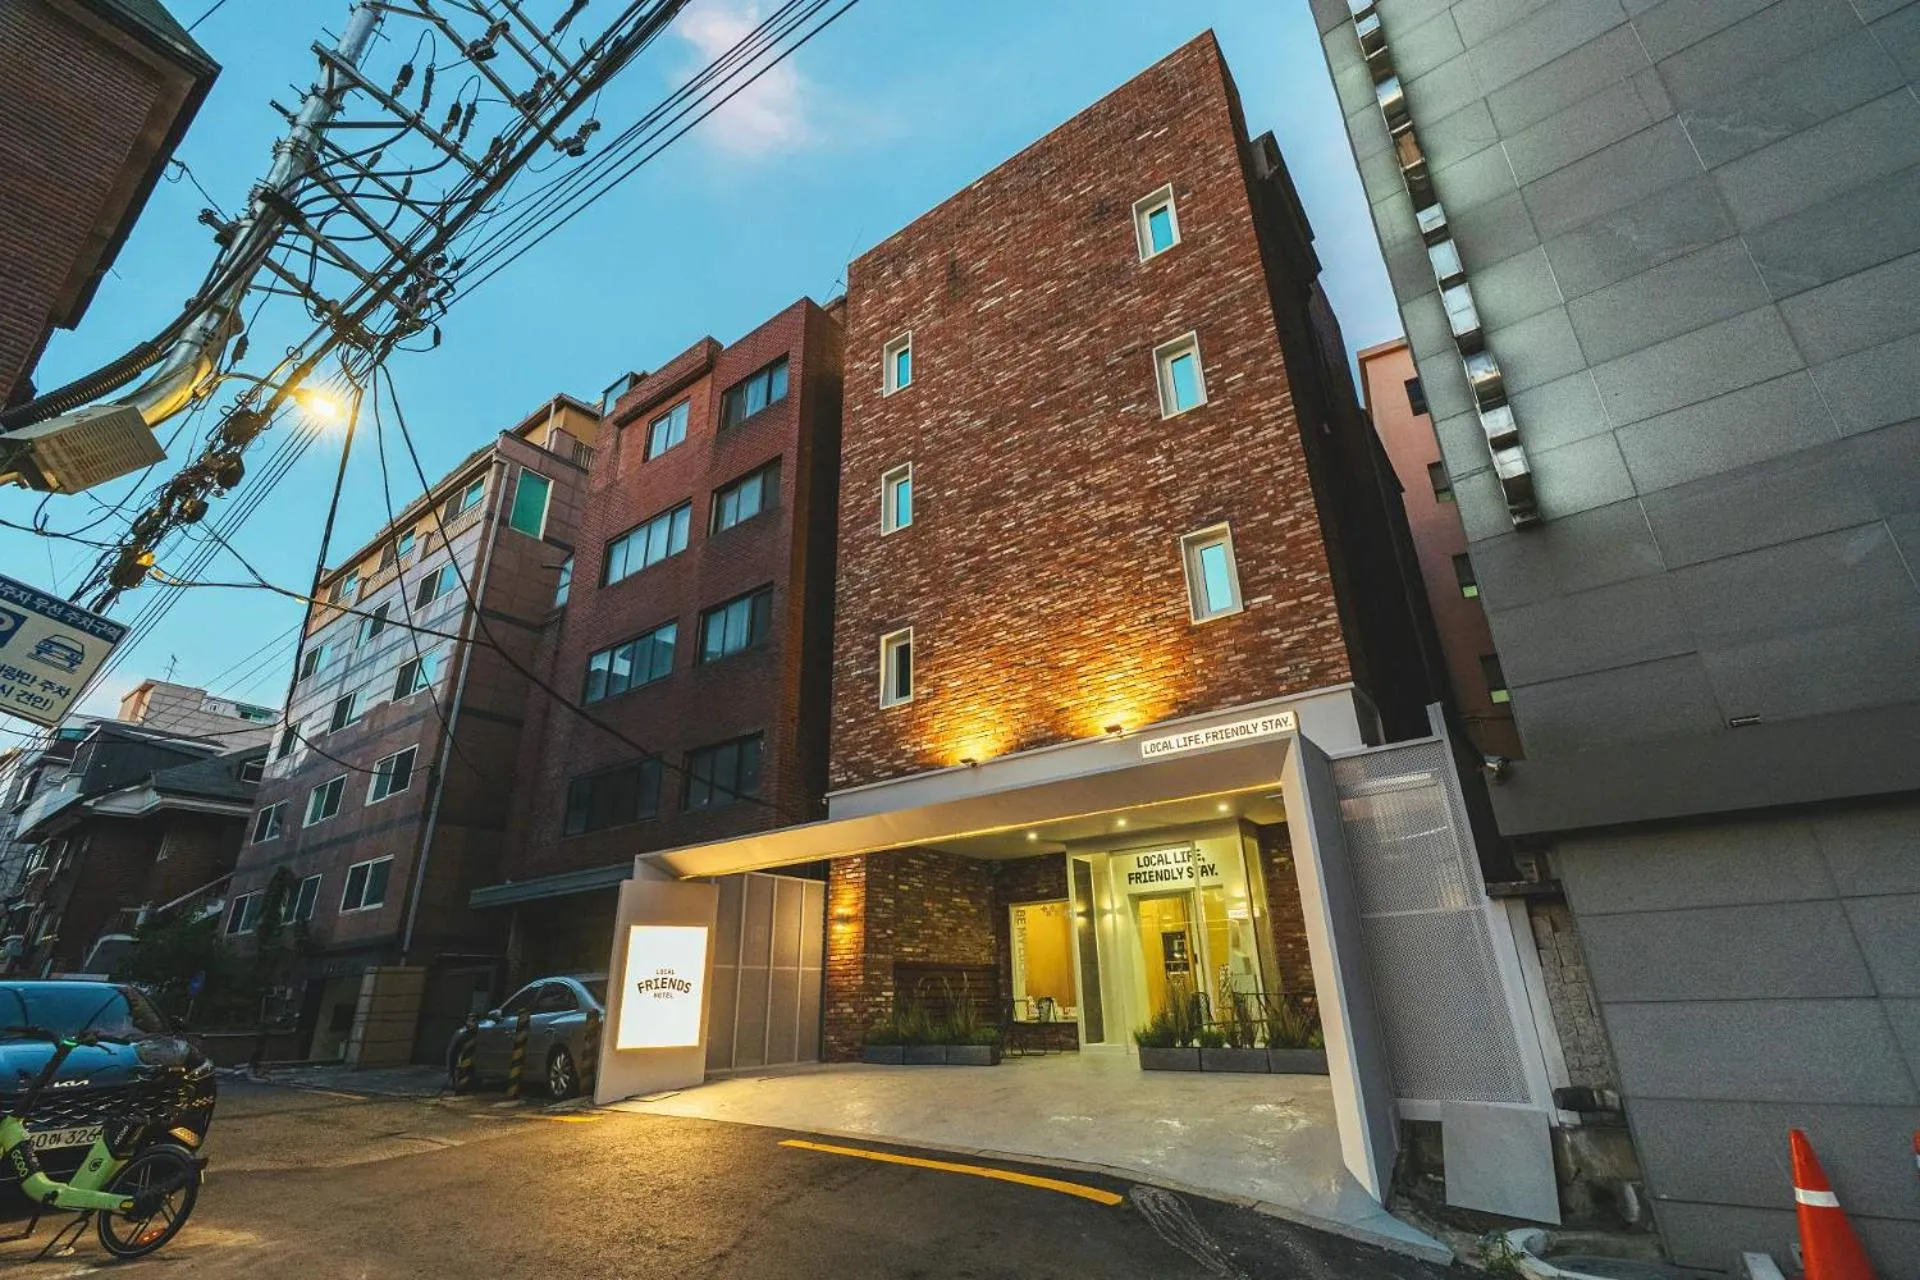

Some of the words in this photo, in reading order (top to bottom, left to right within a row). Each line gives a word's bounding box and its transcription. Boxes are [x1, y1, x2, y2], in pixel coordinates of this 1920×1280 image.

[0, 582, 33, 605] 주자
[34, 597, 63, 617] 우선
[66, 609, 121, 641] 주차구역
[15, 688, 54, 711] 견인)
[40, 679, 71, 700] 주차
[1144, 740, 1173, 755] LOCAL
[1205, 724, 1258, 744] FRIENDLY
[1261, 716, 1293, 733] STAY.
[1137, 852, 1171, 868] LOCAL
[1128, 867, 1183, 885] FRIENDLY
[1184, 863, 1219, 879] SAY.
[655, 968, 675, 976] LOCAL
[637, 977, 692, 994] FRIENDS
